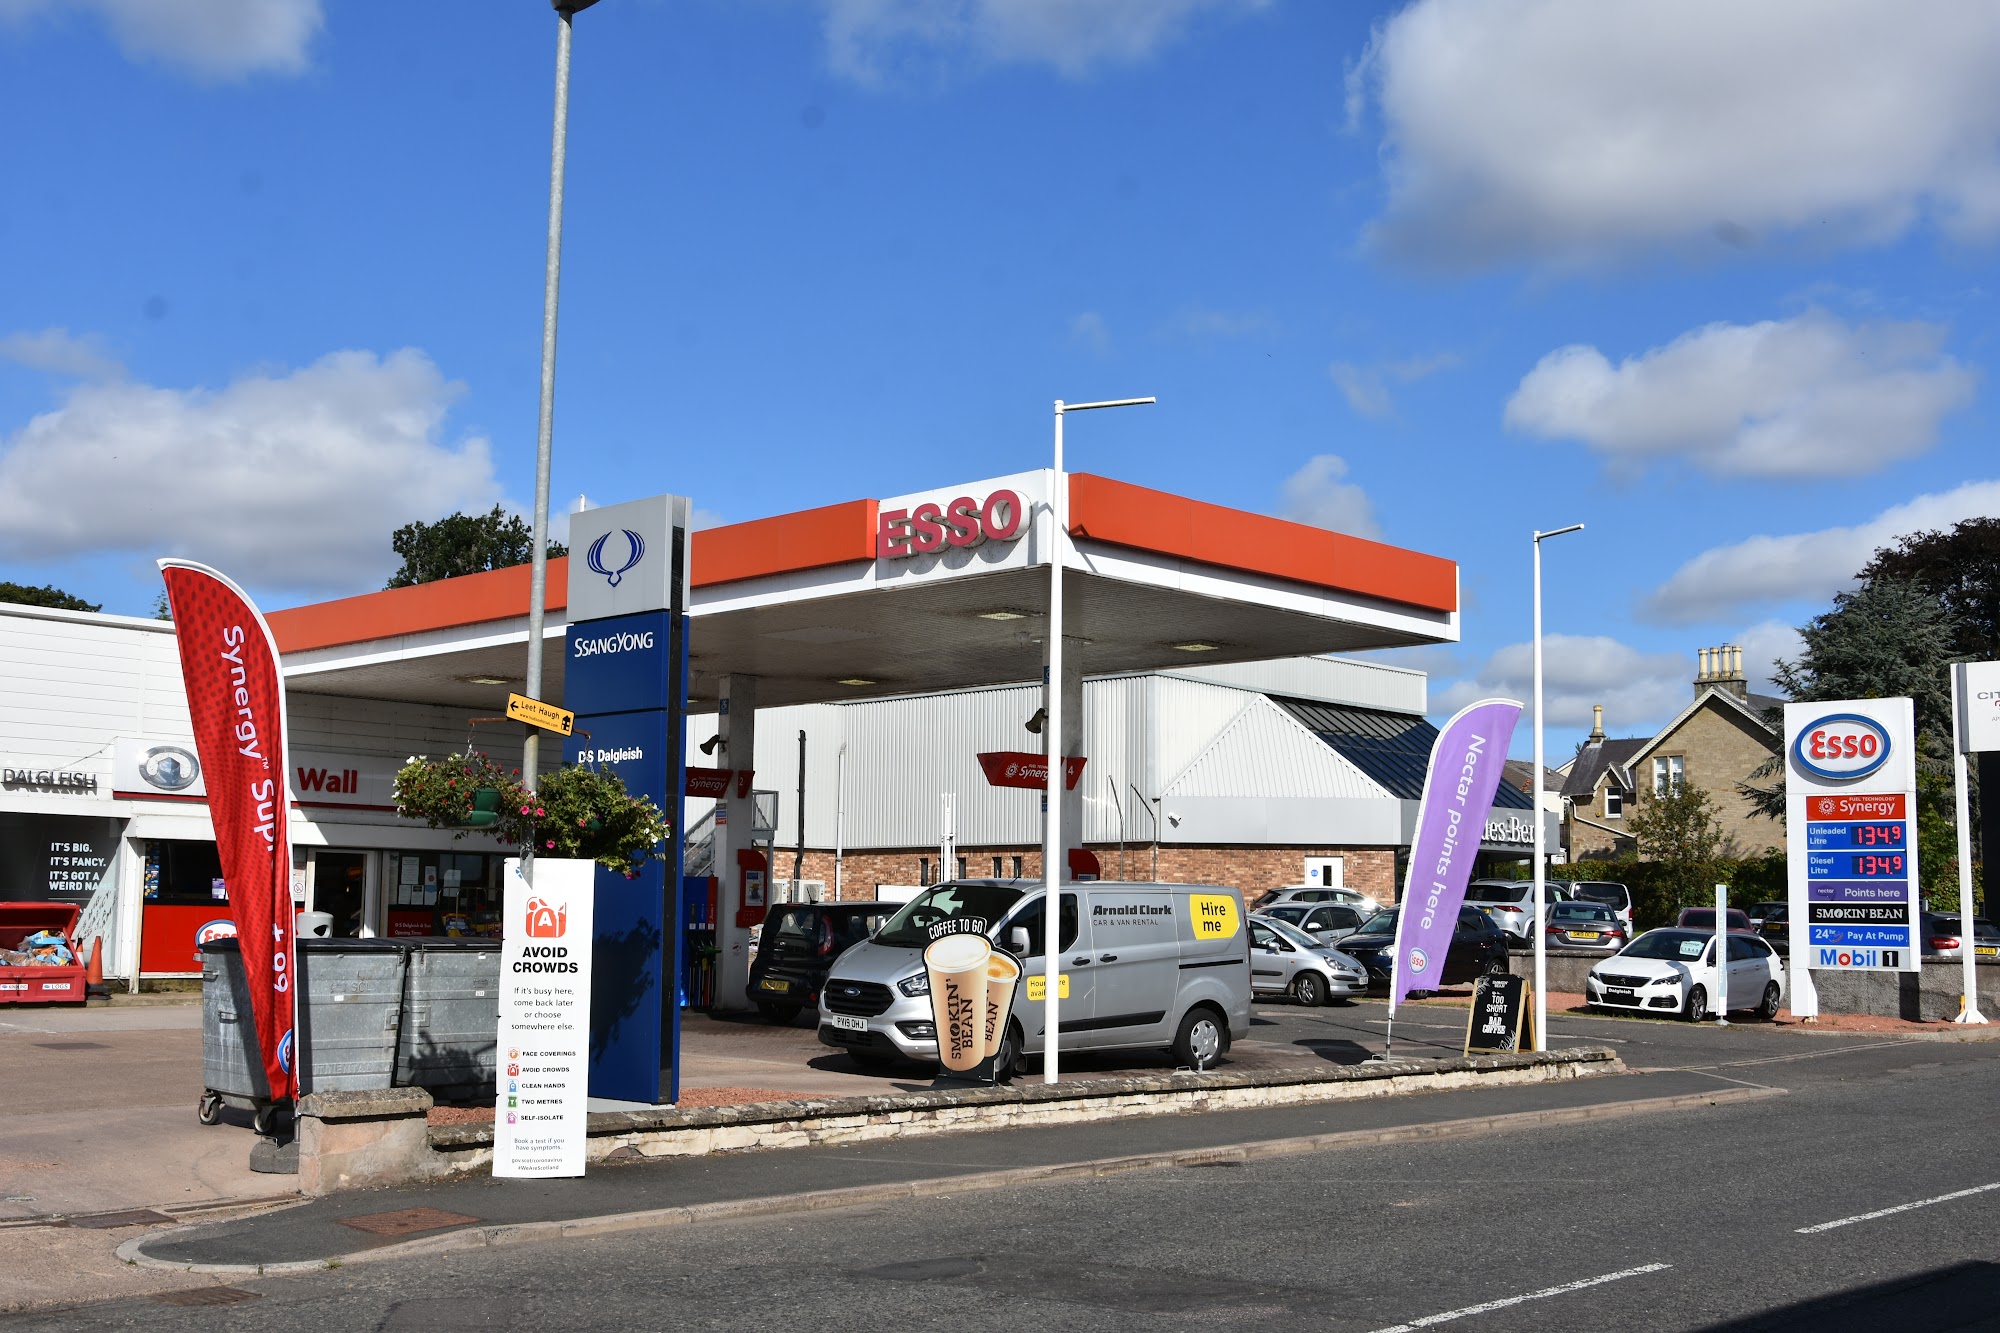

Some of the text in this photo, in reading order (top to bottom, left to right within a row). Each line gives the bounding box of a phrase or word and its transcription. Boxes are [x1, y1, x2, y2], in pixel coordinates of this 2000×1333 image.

[877, 489, 1022, 559] ESSO
[521, 701, 560, 720] Leet Haugh
[1811, 730, 1877, 758] Esso
[597, 746, 643, 764] Dalgleish
[1018, 766, 1048, 781] Synerg
[1067, 765, 1074, 776] 4
[3, 768, 97, 789] DALGLEISH
[297, 767, 358, 794] Wall
[738, 777, 744, 786] 2
[689, 778, 726, 791] Synergy
[1839, 800, 1896, 816] Synergy
[1420, 733, 1487, 930] Nectar points here
[1809, 827, 1847, 835] Unleaded
[1857, 825, 1902, 846] 134.9
[1809, 837, 1828, 845] Litre
[51, 842, 93, 853] IT'S BIG.
[50, 856, 107, 867] IT'S FANCY.
[1810, 857, 1834, 865] Diesel
[1859, 855, 1902, 875] 134.9
[49, 871, 100, 881] IT'S GOT A
[49, 881, 82, 891] WEIRD
[1844, 887, 1901, 898] Points here
[1092, 904, 1172, 915] Arnold Clark
[1200, 901, 1226, 916] Hire
[1869, 908, 1903, 919] BEAN
[928, 918, 984, 940] COFFEE TO GO
[1203, 921, 1222, 932] me
[1847, 931, 1864, 941] Pay
[1865, 931, 1876, 940] At
[1878, 931, 1904, 942] Pump
[522, 946, 568, 958] AVOID
[1820, 948, 1893, 967] Mobil 1
[512, 962, 579, 974] CROWDS
[514, 987, 520, 995] If
[534, 987, 552, 996] busy
[554, 987, 575, 996] here,
[1030, 989, 1046, 997] avail
[1607, 987, 1632, 996] Dalgleish
[535, 998, 553, 1007] back
[556, 998, 574, 1007] later
[1492, 995, 1505, 1004] TOO
[534, 1010, 562, 1018] choose
[1486, 1004, 1508, 1013] SHORT
[511, 1022, 575, 1030] somewhere else.
[960, 998, 974, 1048] BEAN
[984, 1002, 999, 1042] BEAN
[1488, 1016, 1503, 1025] BAD
[1482, 1024, 1506, 1034] COFFEE
